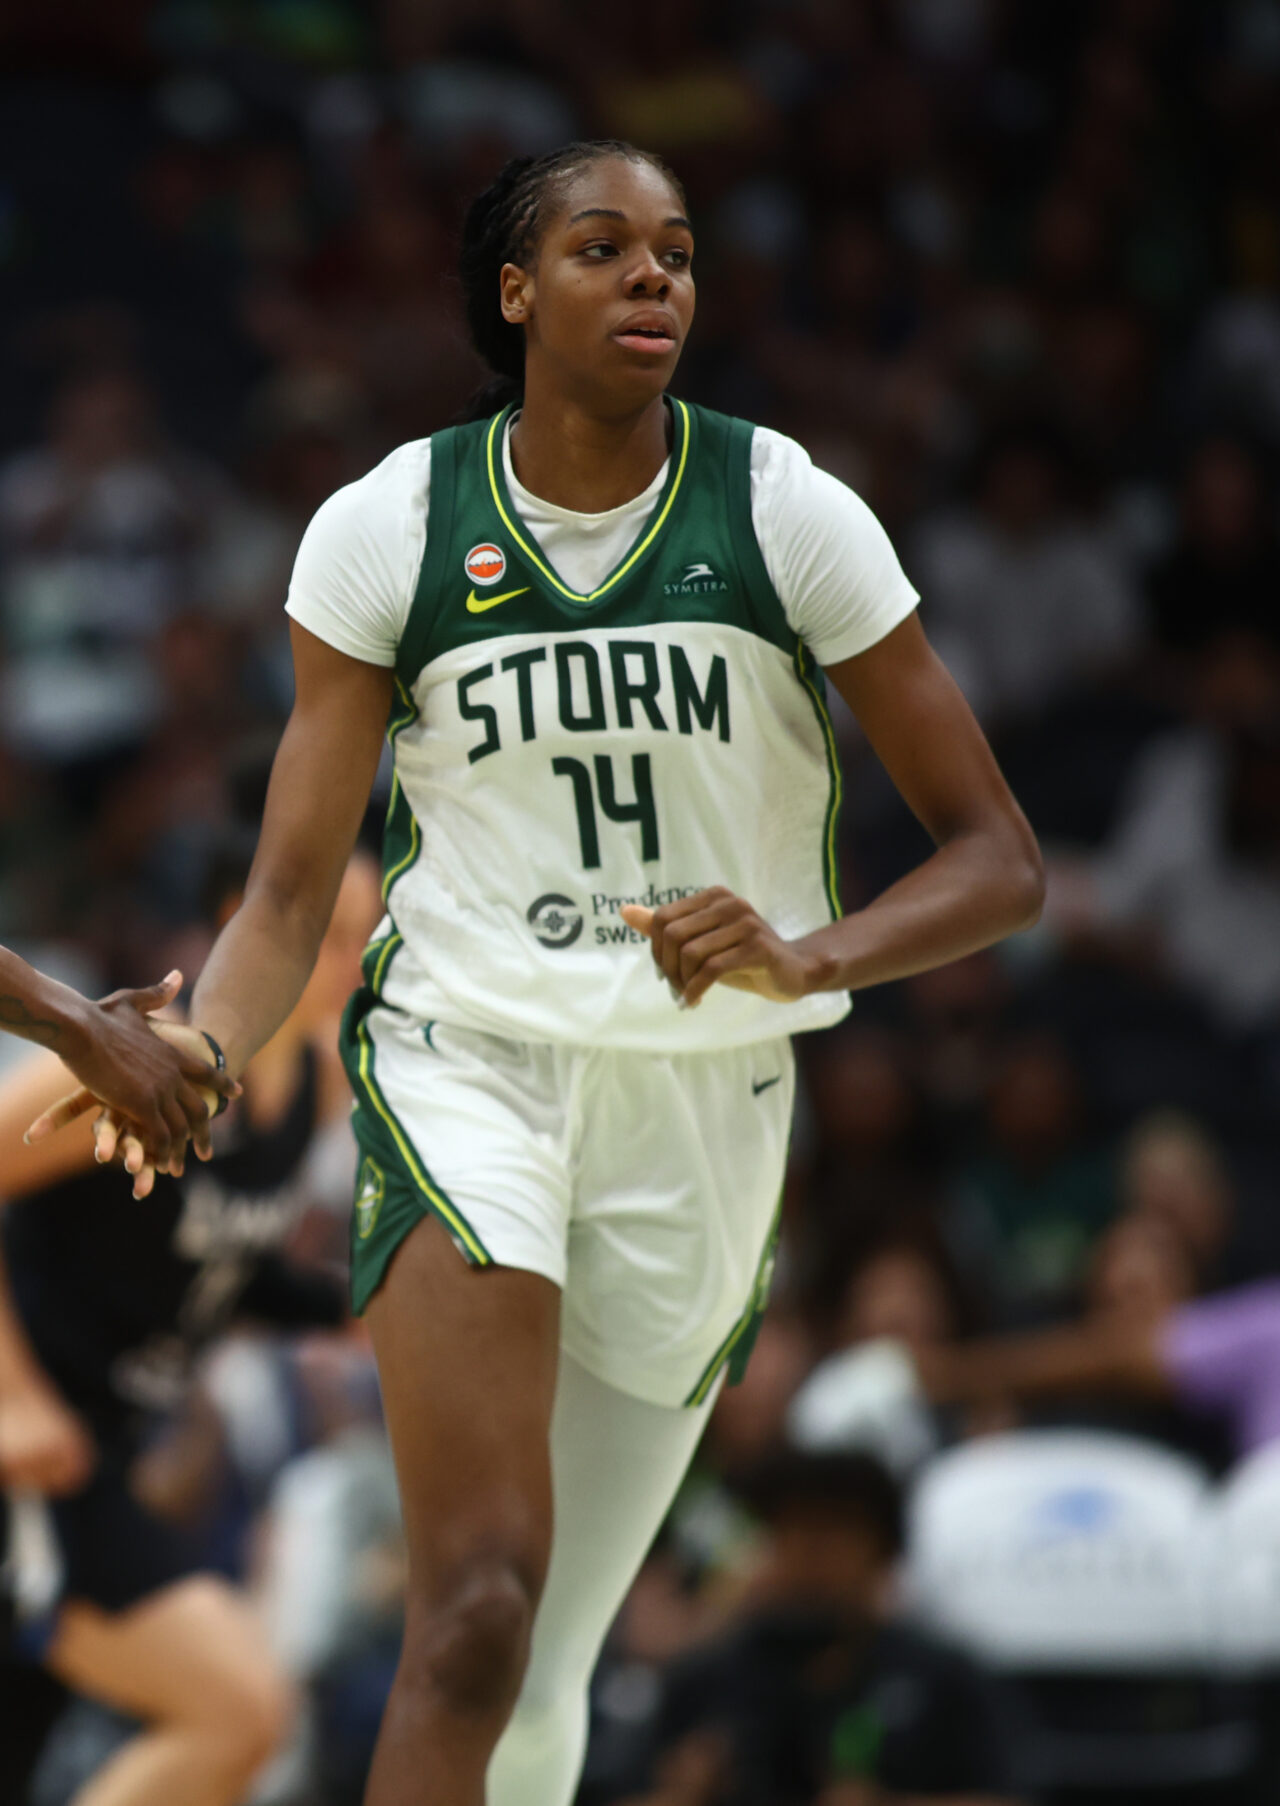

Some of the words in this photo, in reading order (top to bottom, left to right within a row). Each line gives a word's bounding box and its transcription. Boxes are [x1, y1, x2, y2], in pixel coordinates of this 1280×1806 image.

[663, 581, 728, 595] SYMETRA
[457, 640, 731, 766] STORM
[551, 753, 659, 870] 14
